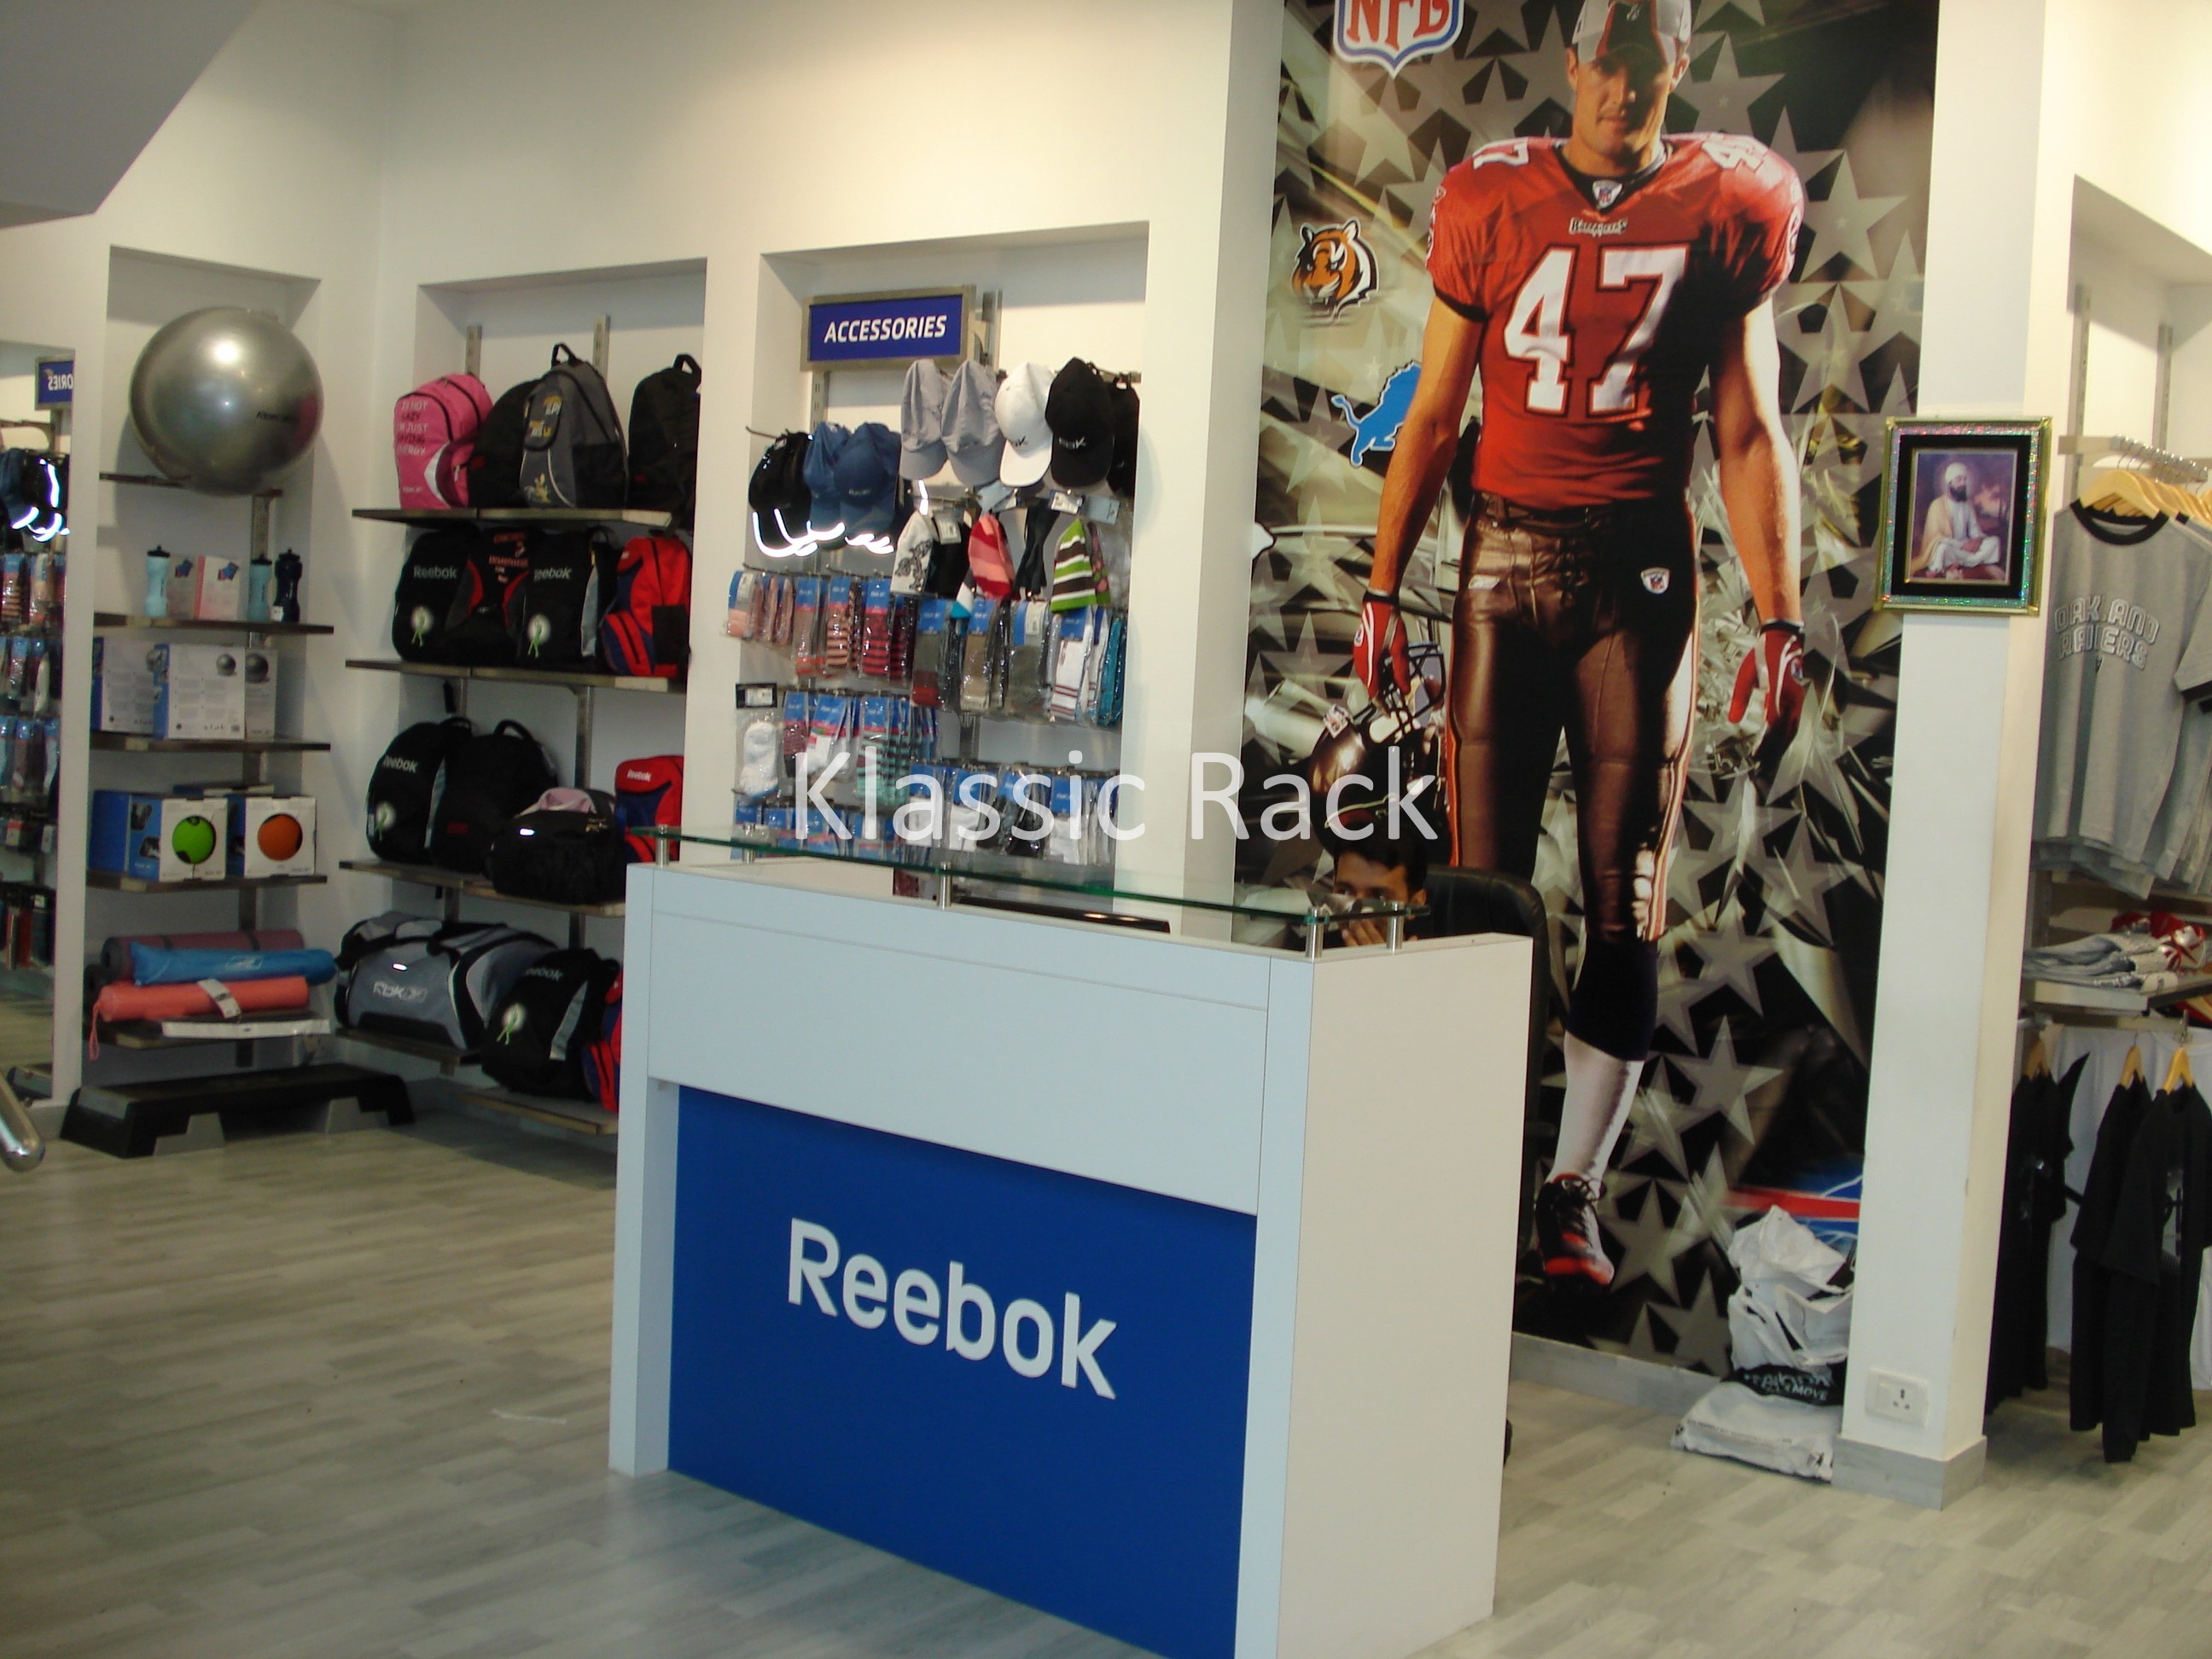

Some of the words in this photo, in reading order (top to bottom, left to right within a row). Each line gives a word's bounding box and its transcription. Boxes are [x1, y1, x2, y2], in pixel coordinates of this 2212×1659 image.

[824, 314, 948, 343] ACCESSORIES
[1503, 246, 1689, 413] 47
[413, 564, 458, 579] Reebok
[2054, 594, 2160, 646] OAKAND
[2059, 623, 2149, 671] RAIERS
[788, 1217, 1117, 1400] Reebok
